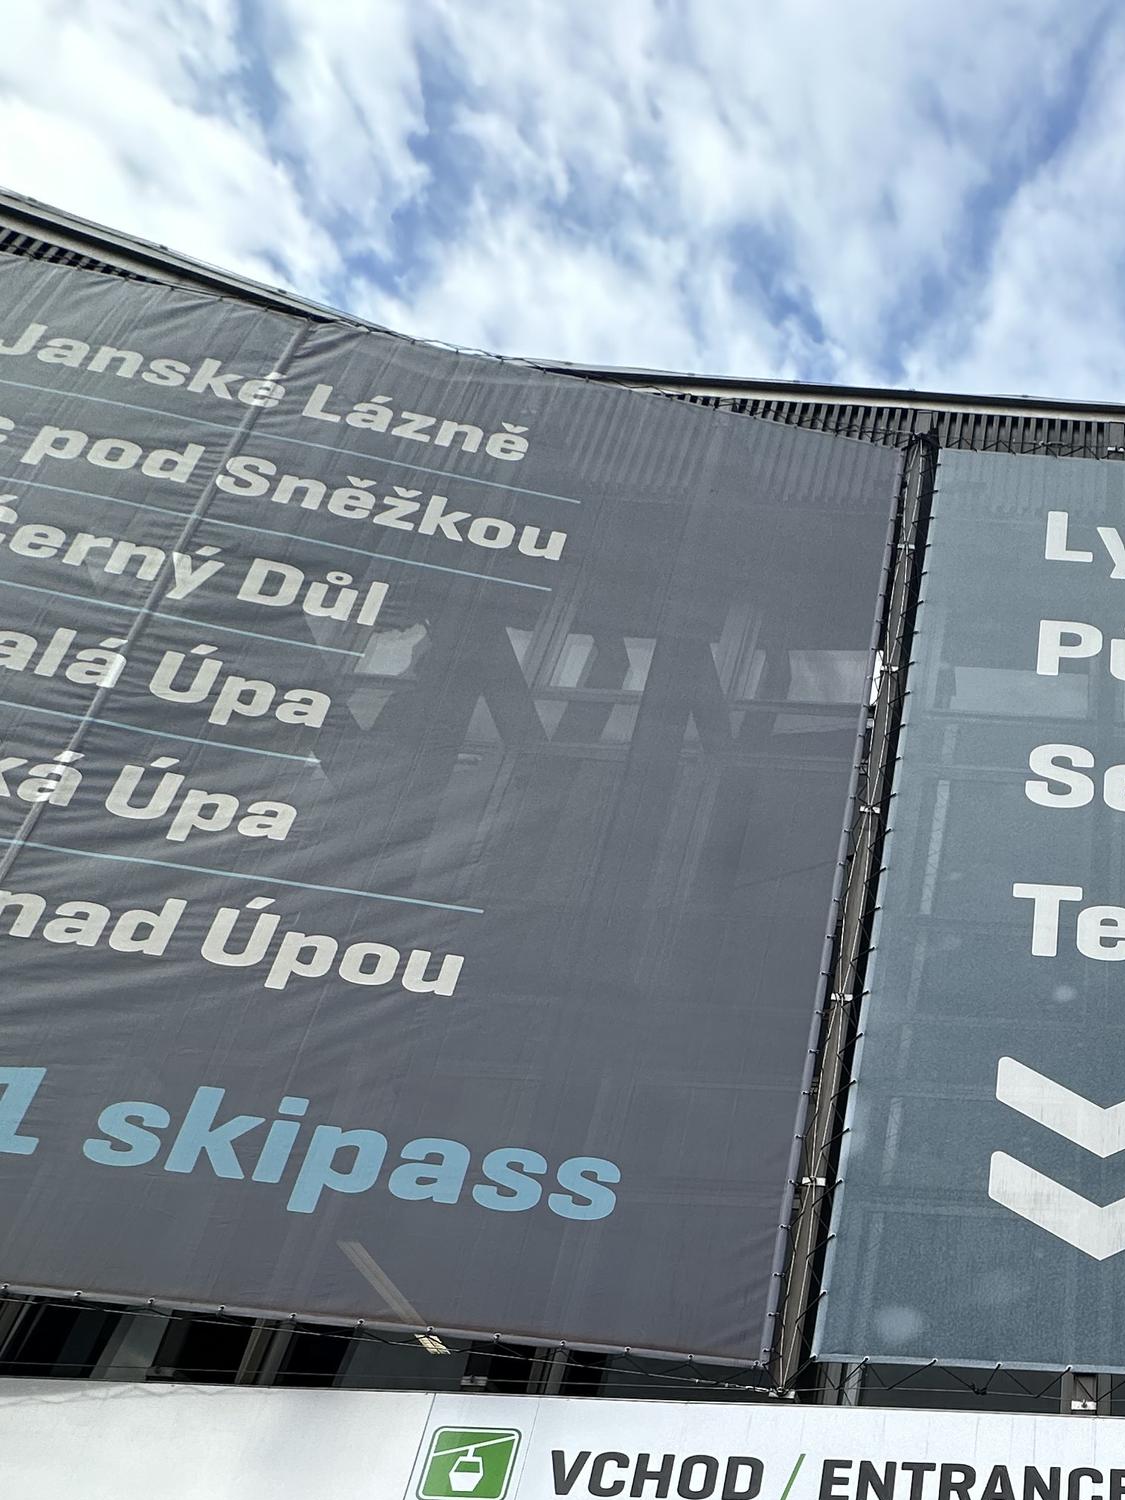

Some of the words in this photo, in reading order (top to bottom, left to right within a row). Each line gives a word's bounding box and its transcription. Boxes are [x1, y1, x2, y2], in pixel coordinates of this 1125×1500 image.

[301, 384, 529, 461] Lázně
[20, 424, 204, 487] pod
[216, 454, 567, 562] Sněžkou
[237, 558, 389, 627] Důl
[148, 644, 332, 729] Úpa
[104, 757, 298, 841] Úpa
[0, 887, 188, 956] nad
[200, 897, 465, 996] Úpou
[83, 1085, 622, 1221] skipass
